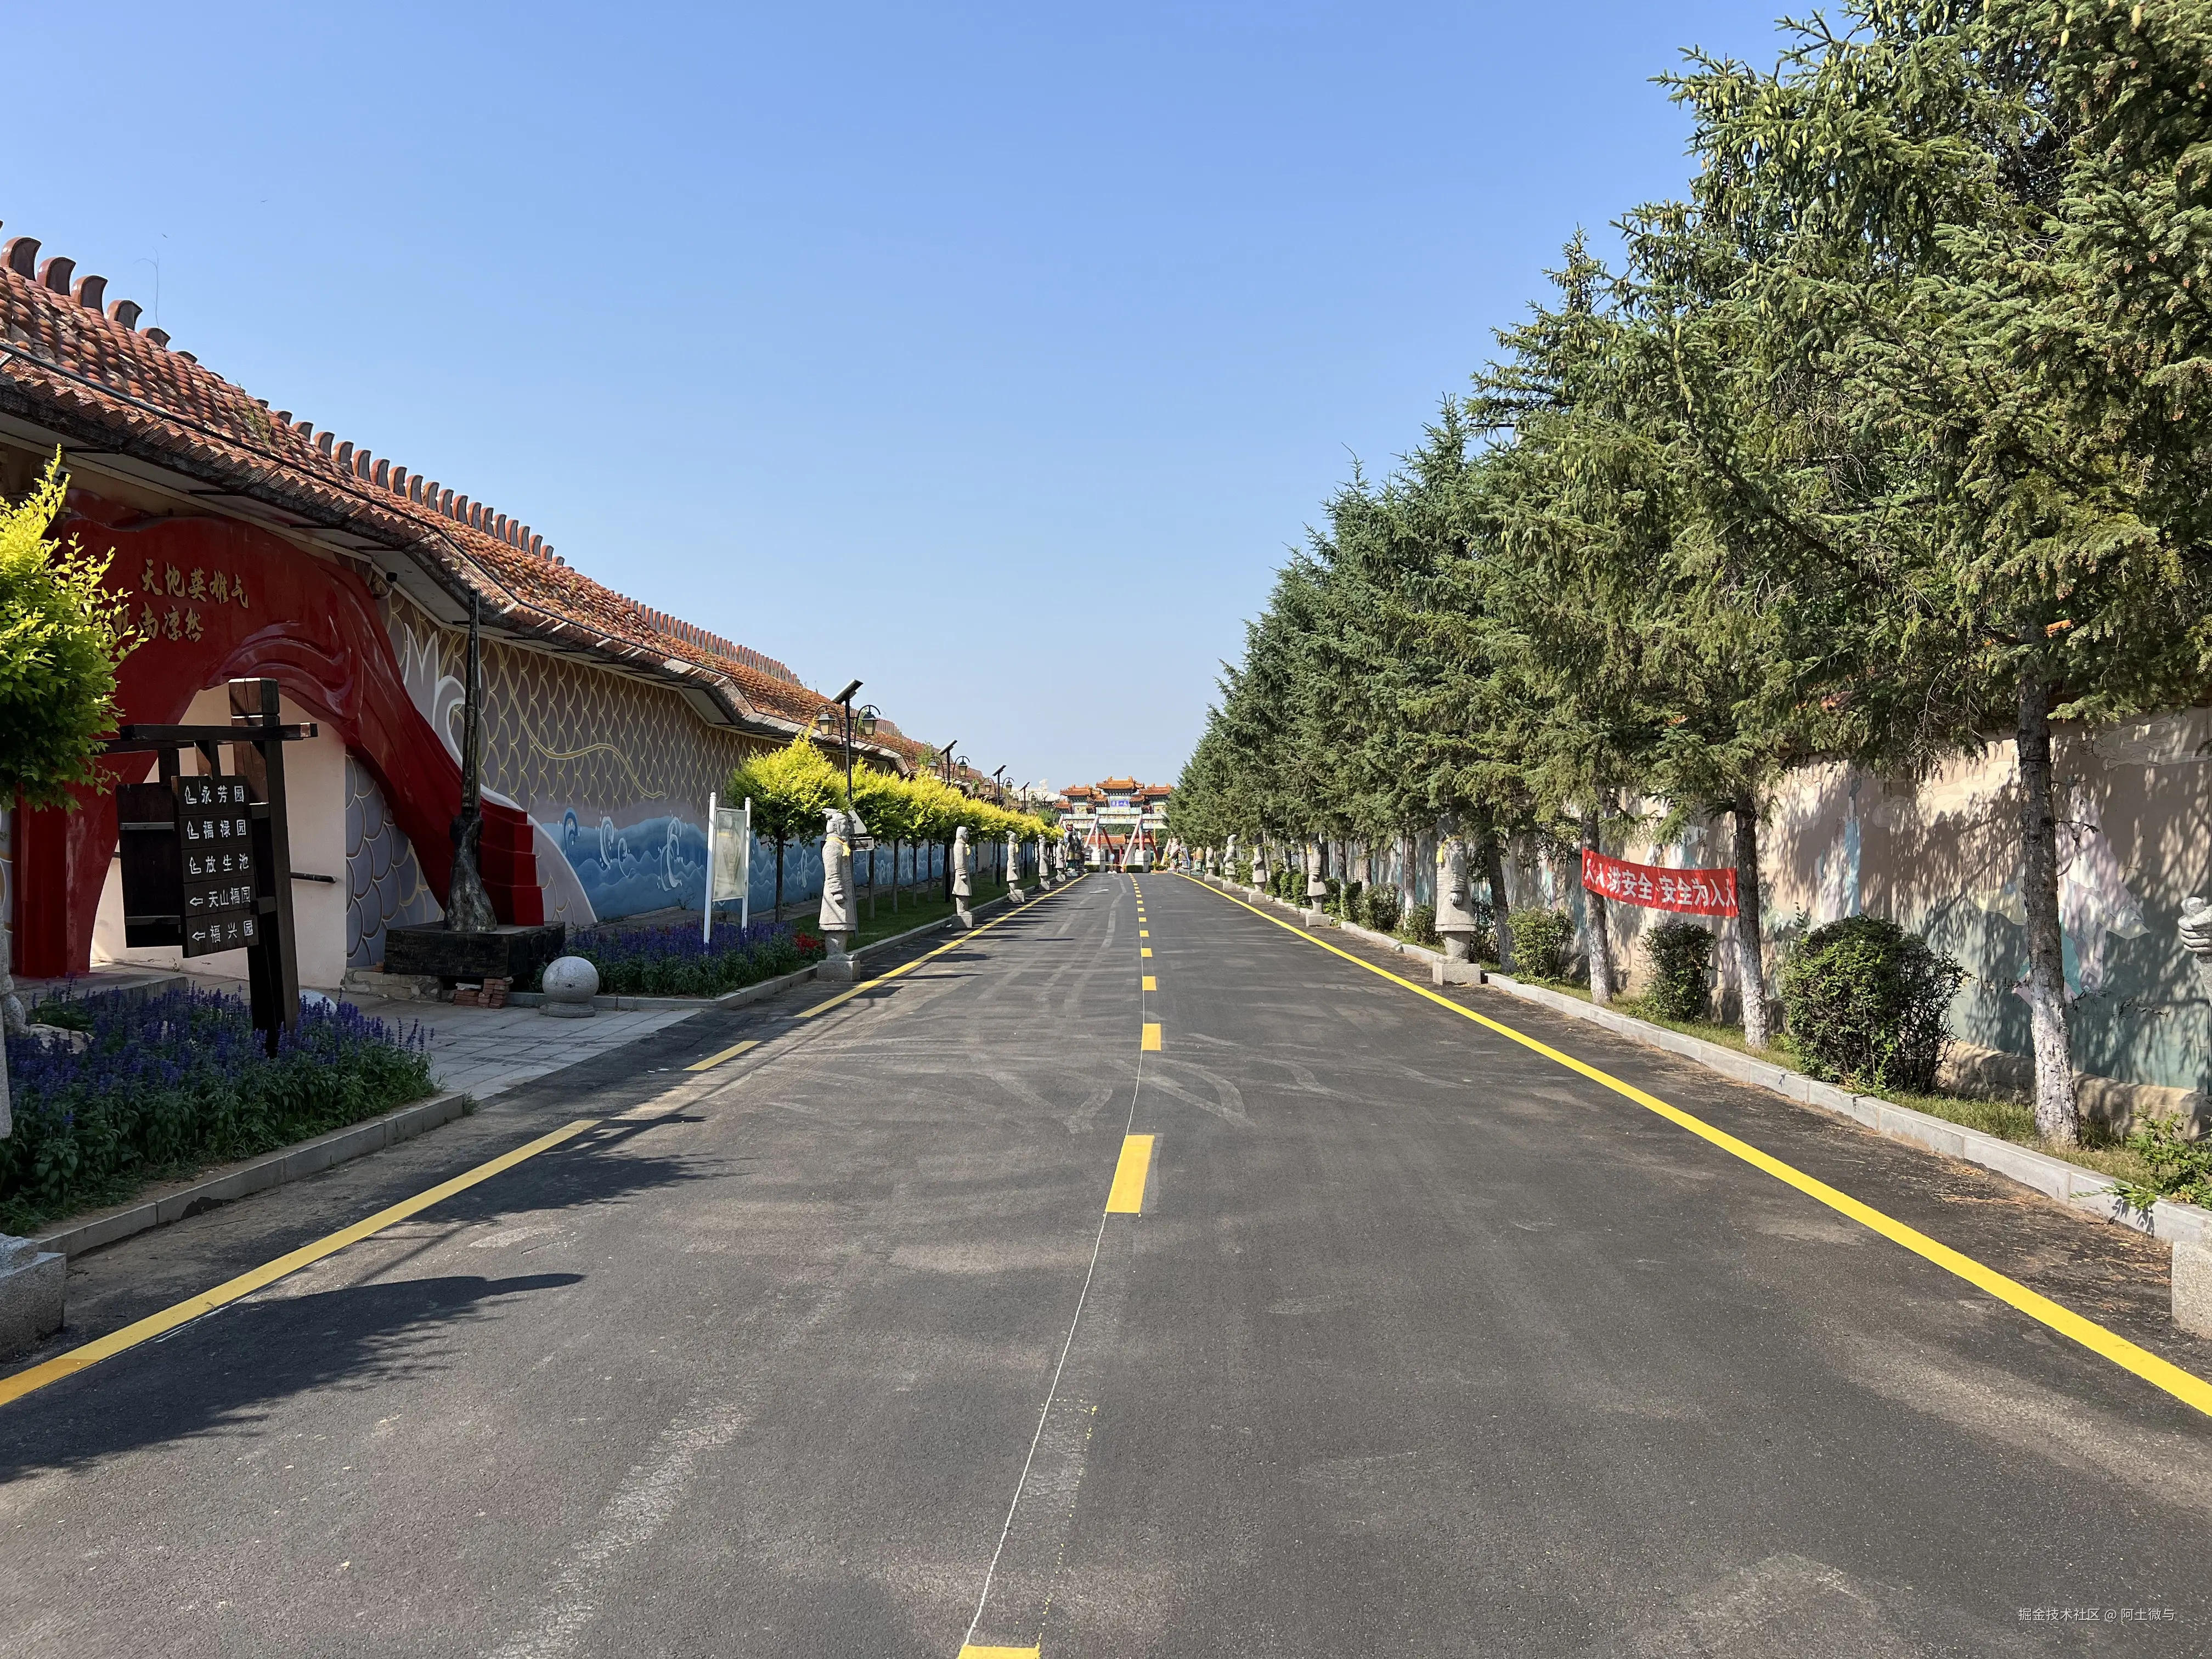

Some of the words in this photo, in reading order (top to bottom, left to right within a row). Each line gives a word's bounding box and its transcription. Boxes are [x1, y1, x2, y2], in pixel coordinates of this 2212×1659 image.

[201, 785, 245, 804] 永芳园
[203, 819, 247, 839] 福禄园
[205, 853, 250, 873] 放生池
[208, 885, 252, 908] 天山福园
[210, 919, 254, 944] 福兴园
